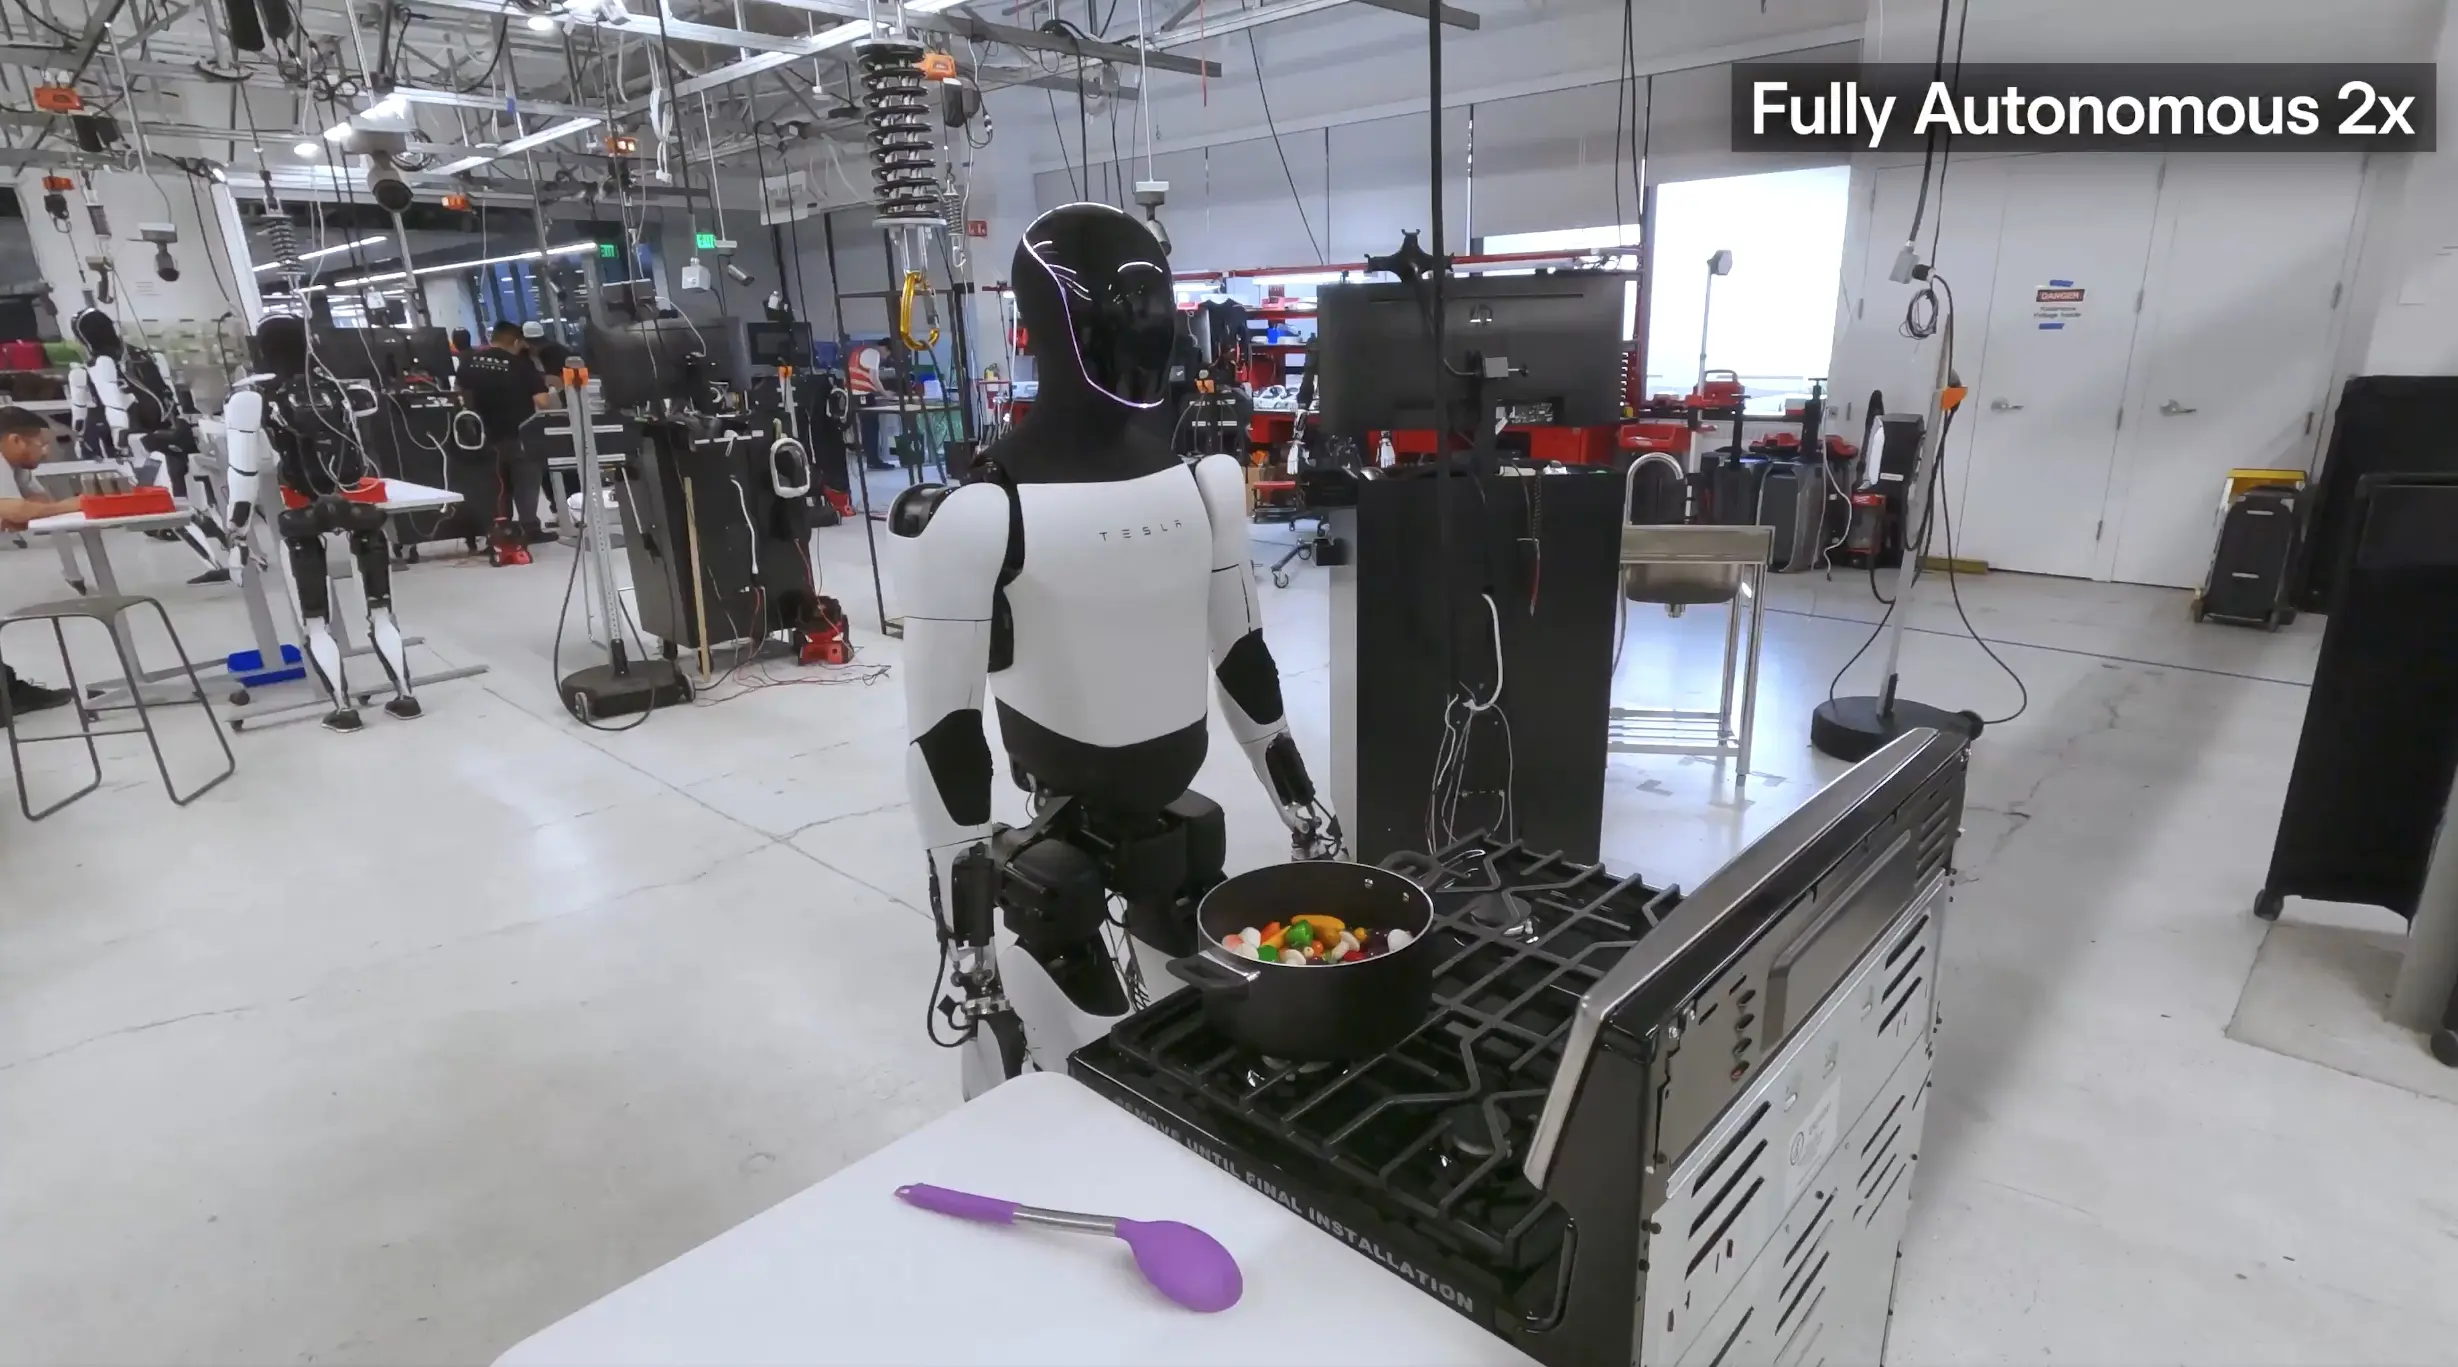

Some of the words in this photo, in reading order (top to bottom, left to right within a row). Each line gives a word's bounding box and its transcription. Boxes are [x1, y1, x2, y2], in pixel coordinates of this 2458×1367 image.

[2040, 291, 2080, 300] DANGER
[1098, 519, 1182, 541] TESLA
[1186, 1137, 1241, 1179] UNTIL
[1245, 1171, 1302, 1214] FINAL
[1308, 1206, 1473, 1313] INSTALLATION
